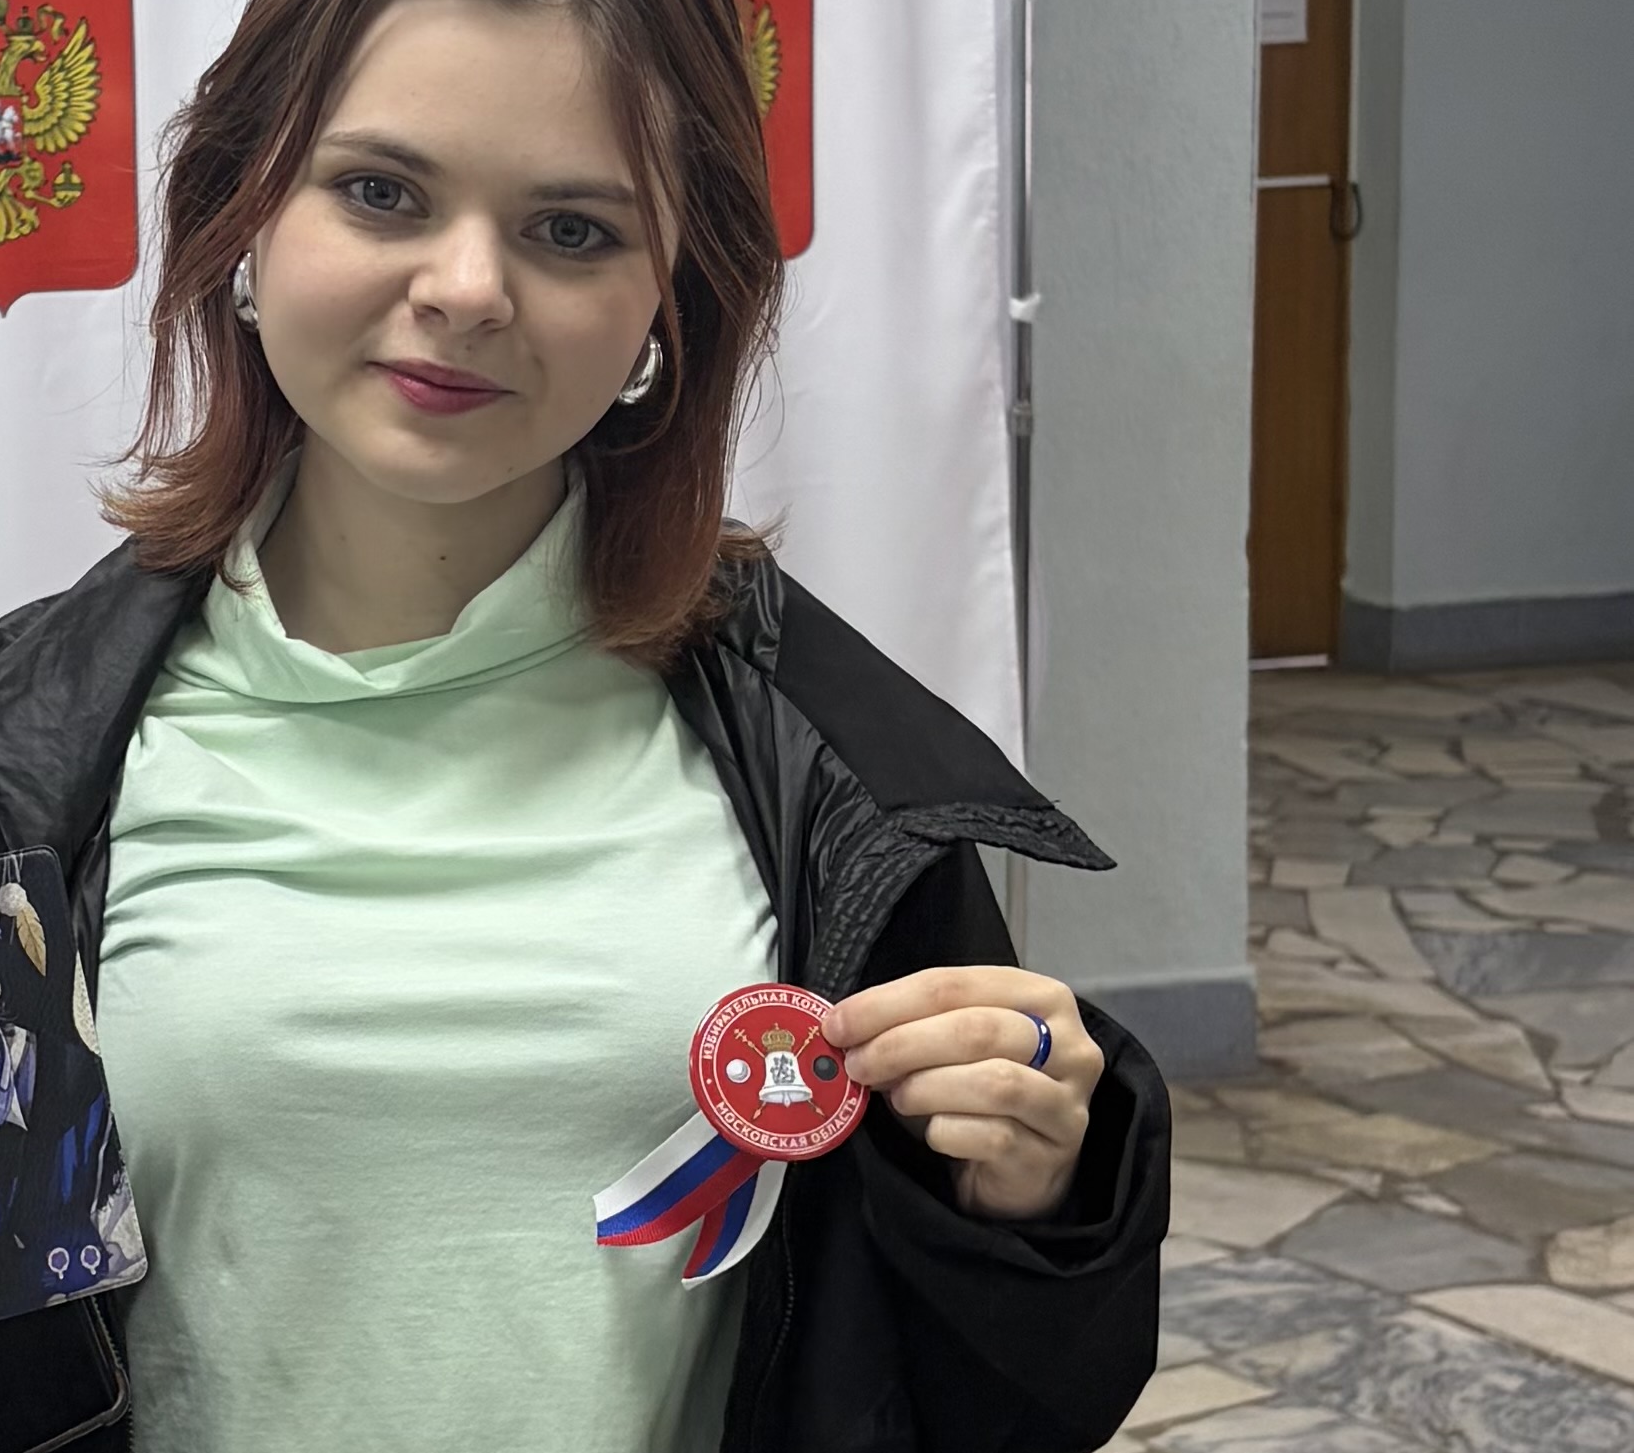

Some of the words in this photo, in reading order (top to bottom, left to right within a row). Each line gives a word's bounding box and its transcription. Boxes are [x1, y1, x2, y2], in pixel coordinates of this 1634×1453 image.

[702, 991, 789, 1060] ИЗБИРАТЕЛЬНАЯ
[715, 1100, 808, 1148] МОСКОВСКАЯ
[810, 1096, 858, 1146] ОБЛАСТЬ
